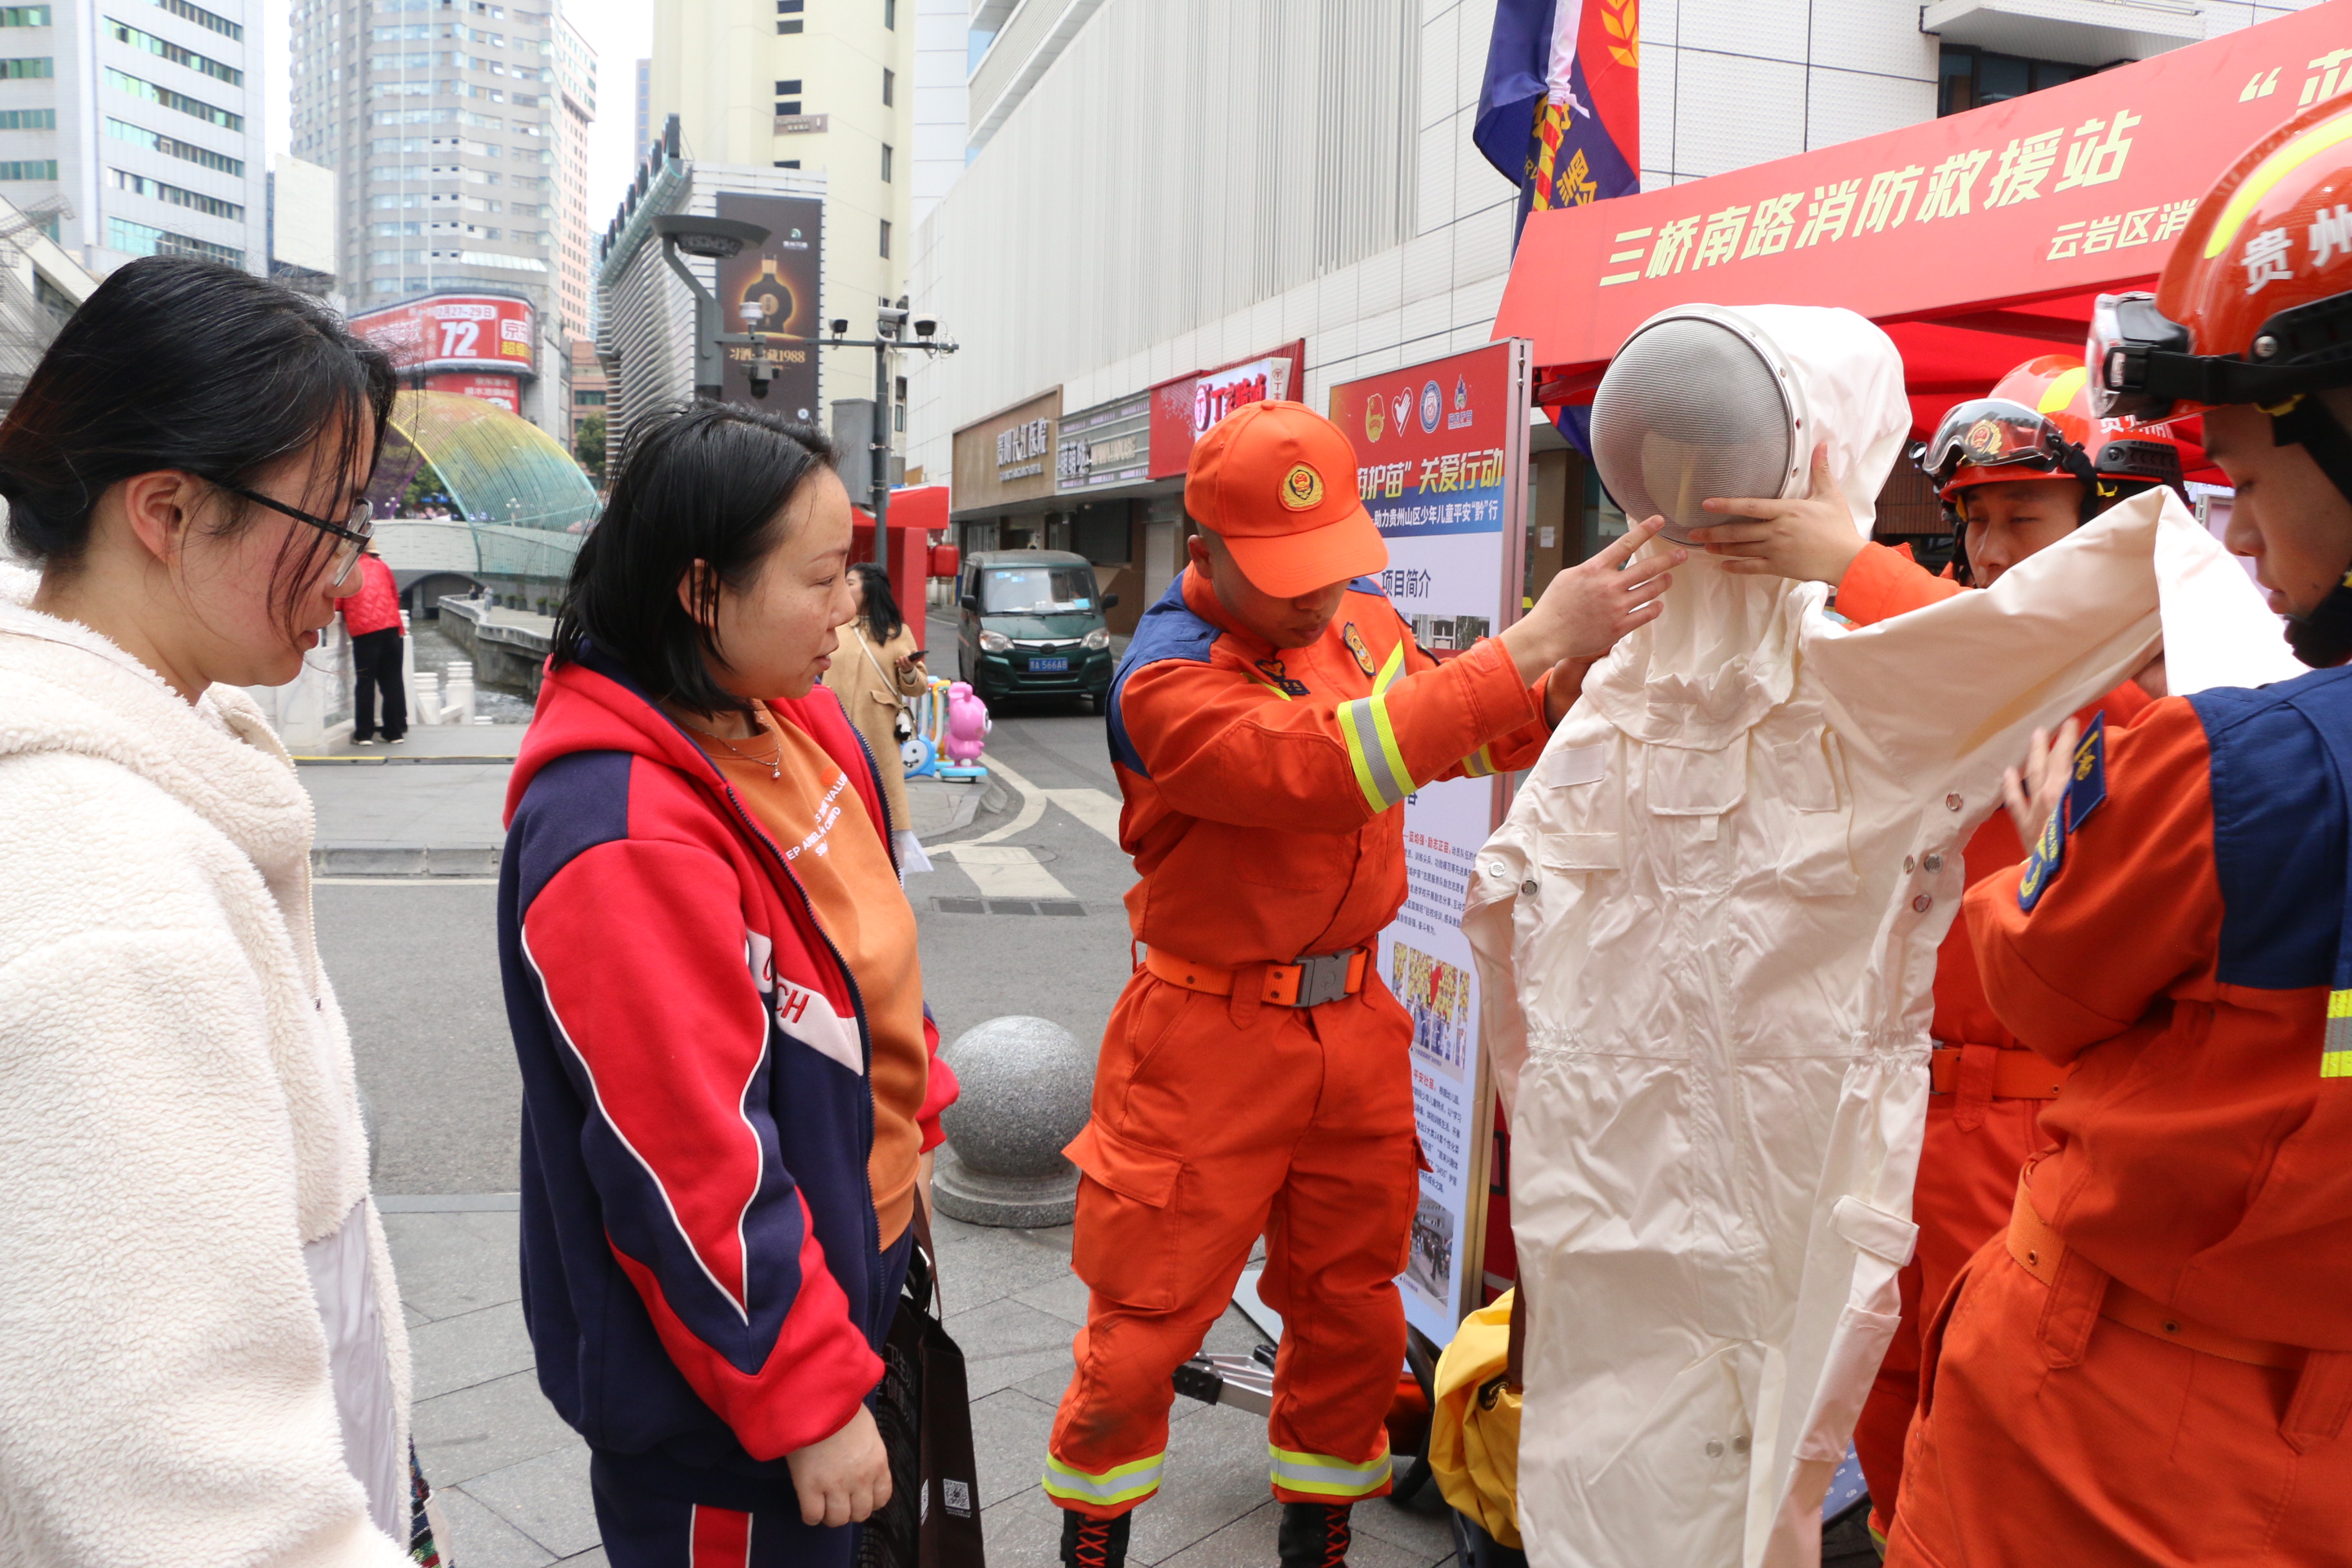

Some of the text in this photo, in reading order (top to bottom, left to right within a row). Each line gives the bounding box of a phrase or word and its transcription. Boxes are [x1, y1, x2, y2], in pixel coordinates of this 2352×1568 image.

[1598, 109, 2142, 287] 三桥南路消防救援站
[440, 321, 480, 357] 12
[1382, 569, 1431, 598] 项目简介
